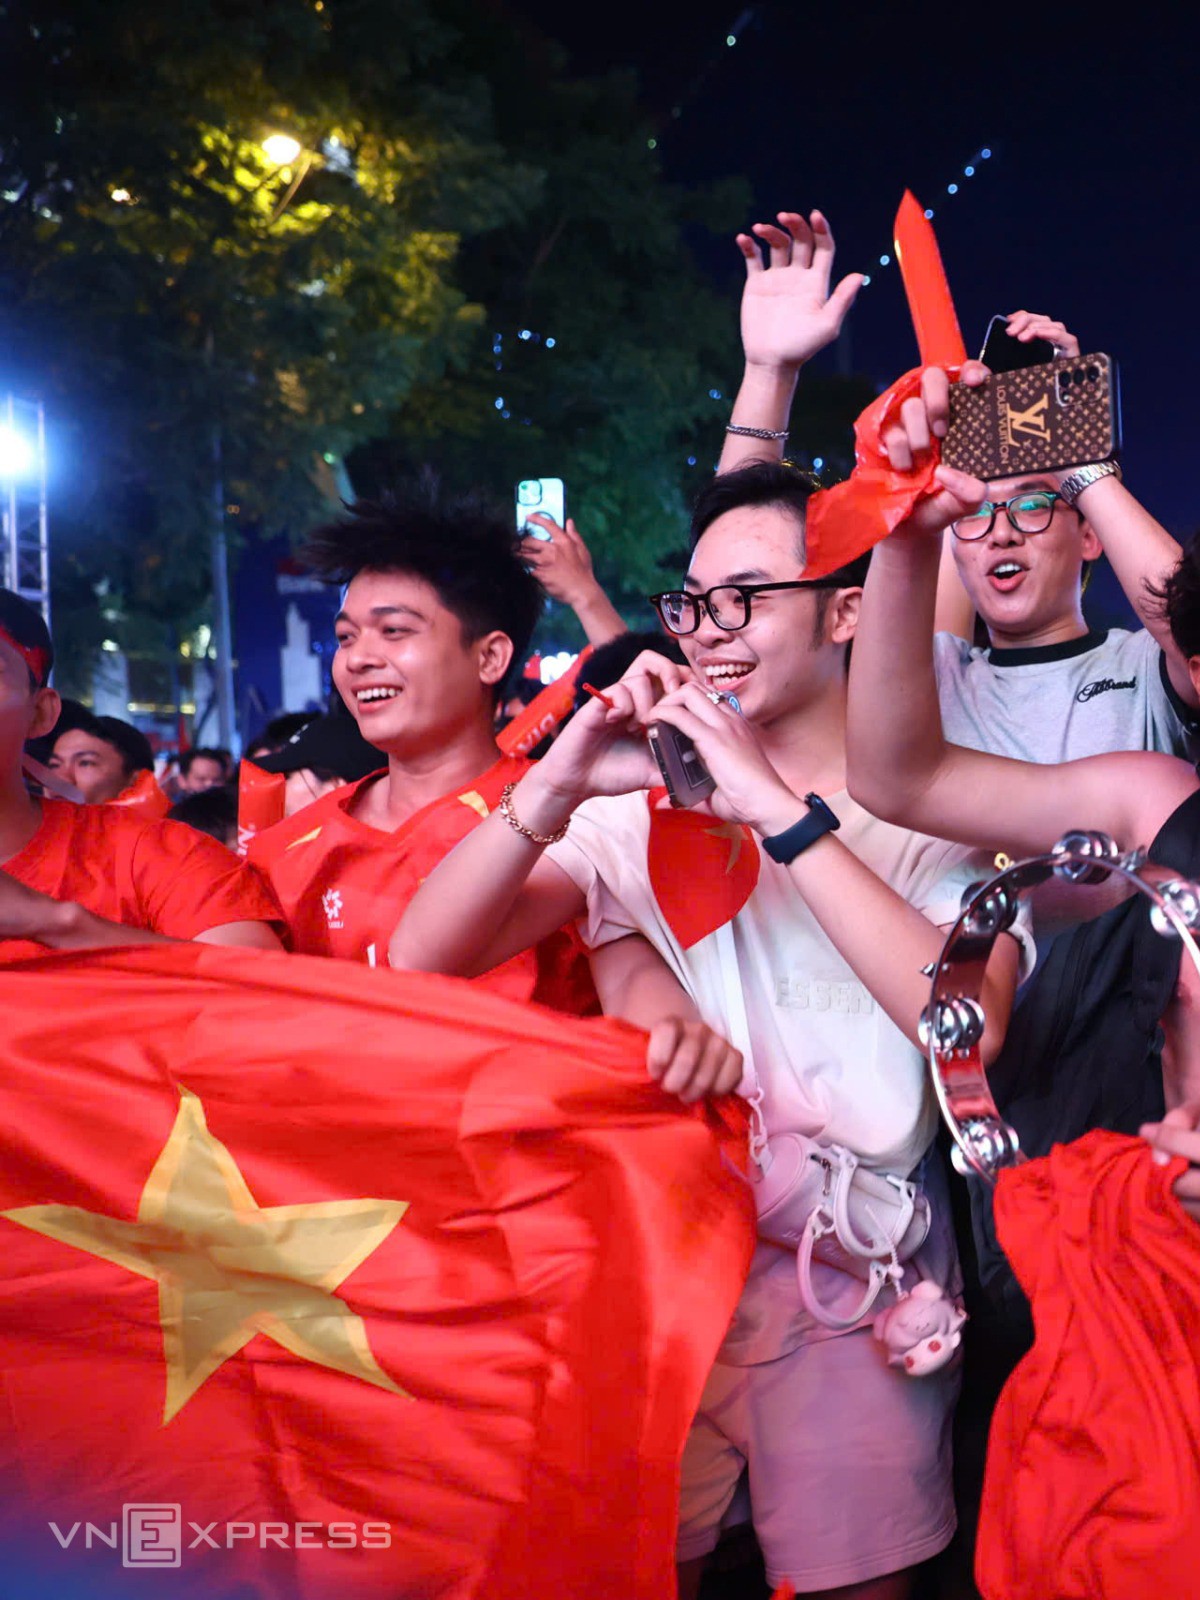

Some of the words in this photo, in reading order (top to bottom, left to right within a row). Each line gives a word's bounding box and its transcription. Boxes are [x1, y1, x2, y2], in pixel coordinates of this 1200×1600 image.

[997, 386, 1007, 415] LOUIS
[999, 417, 1010, 464] VUITTON
[775, 979, 876, 1015] ESSEN
